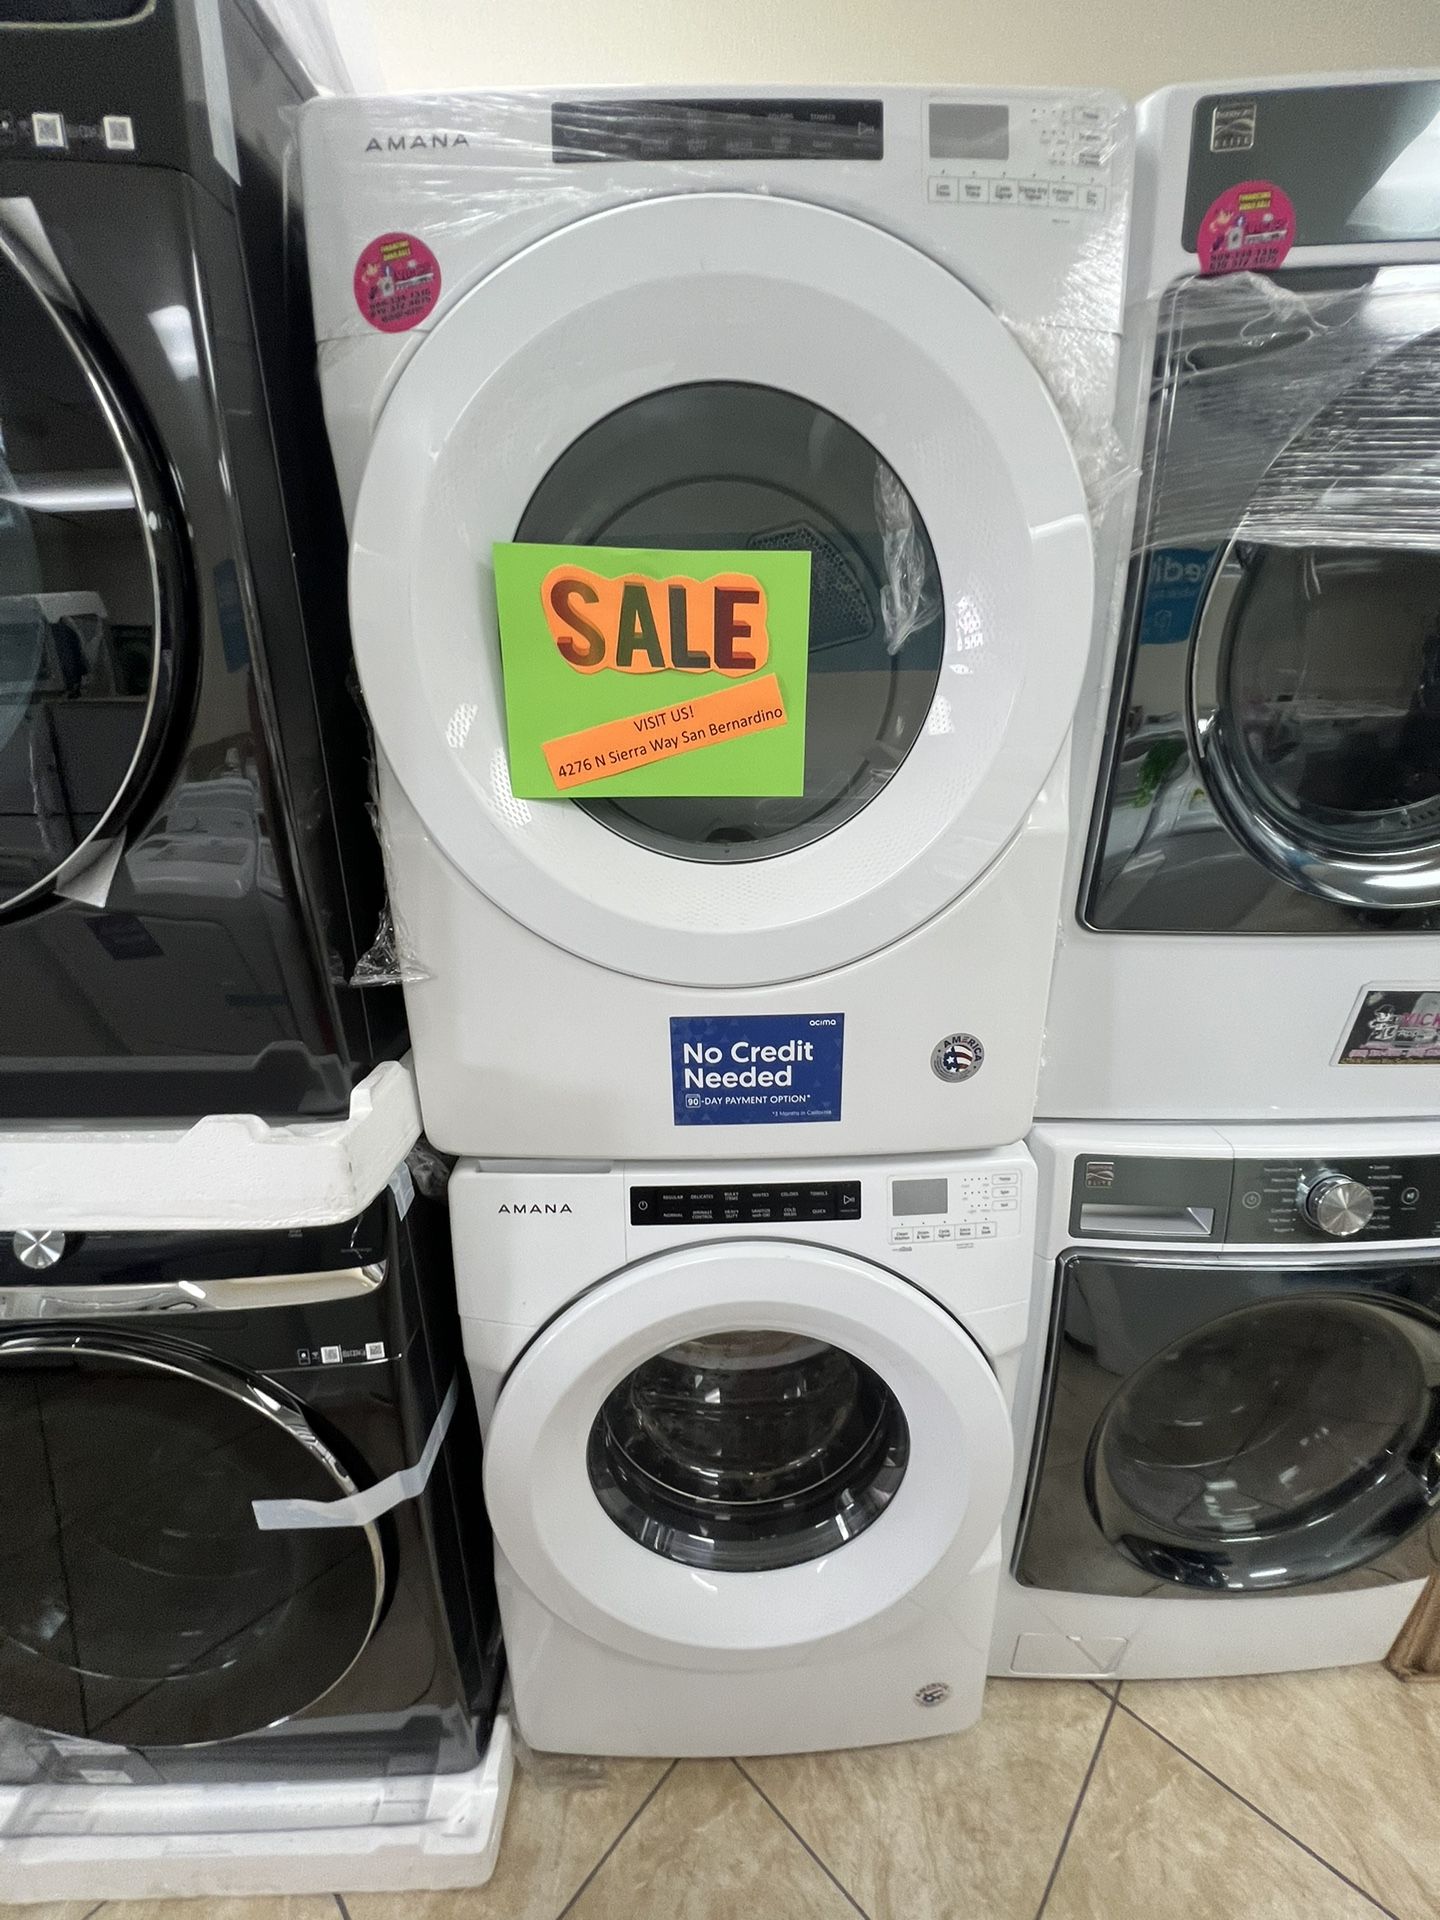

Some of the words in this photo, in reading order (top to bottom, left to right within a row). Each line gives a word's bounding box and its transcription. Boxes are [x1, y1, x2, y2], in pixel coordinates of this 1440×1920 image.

[365, 133, 469, 152] AMANA
[550, 579, 760, 670] SALE
[633, 713, 667, 732] VISIT
[670, 705, 695, 724] US!
[558, 758, 592, 777] 4276
[595, 754, 606, 769] N
[608, 745, 647, 764] Sierra
[649, 736, 679, 753] Way
[681, 729, 706, 744] San
[708, 707, 783, 737] Bernardino
[683, 1042, 723, 1064] No
[730, 1039, 814, 1063] Credit
[684, 1065, 792, 1089] Needed
[725, 1096, 768, 1105] PAYMENT
[498, 1203, 573, 1214] AMANA
